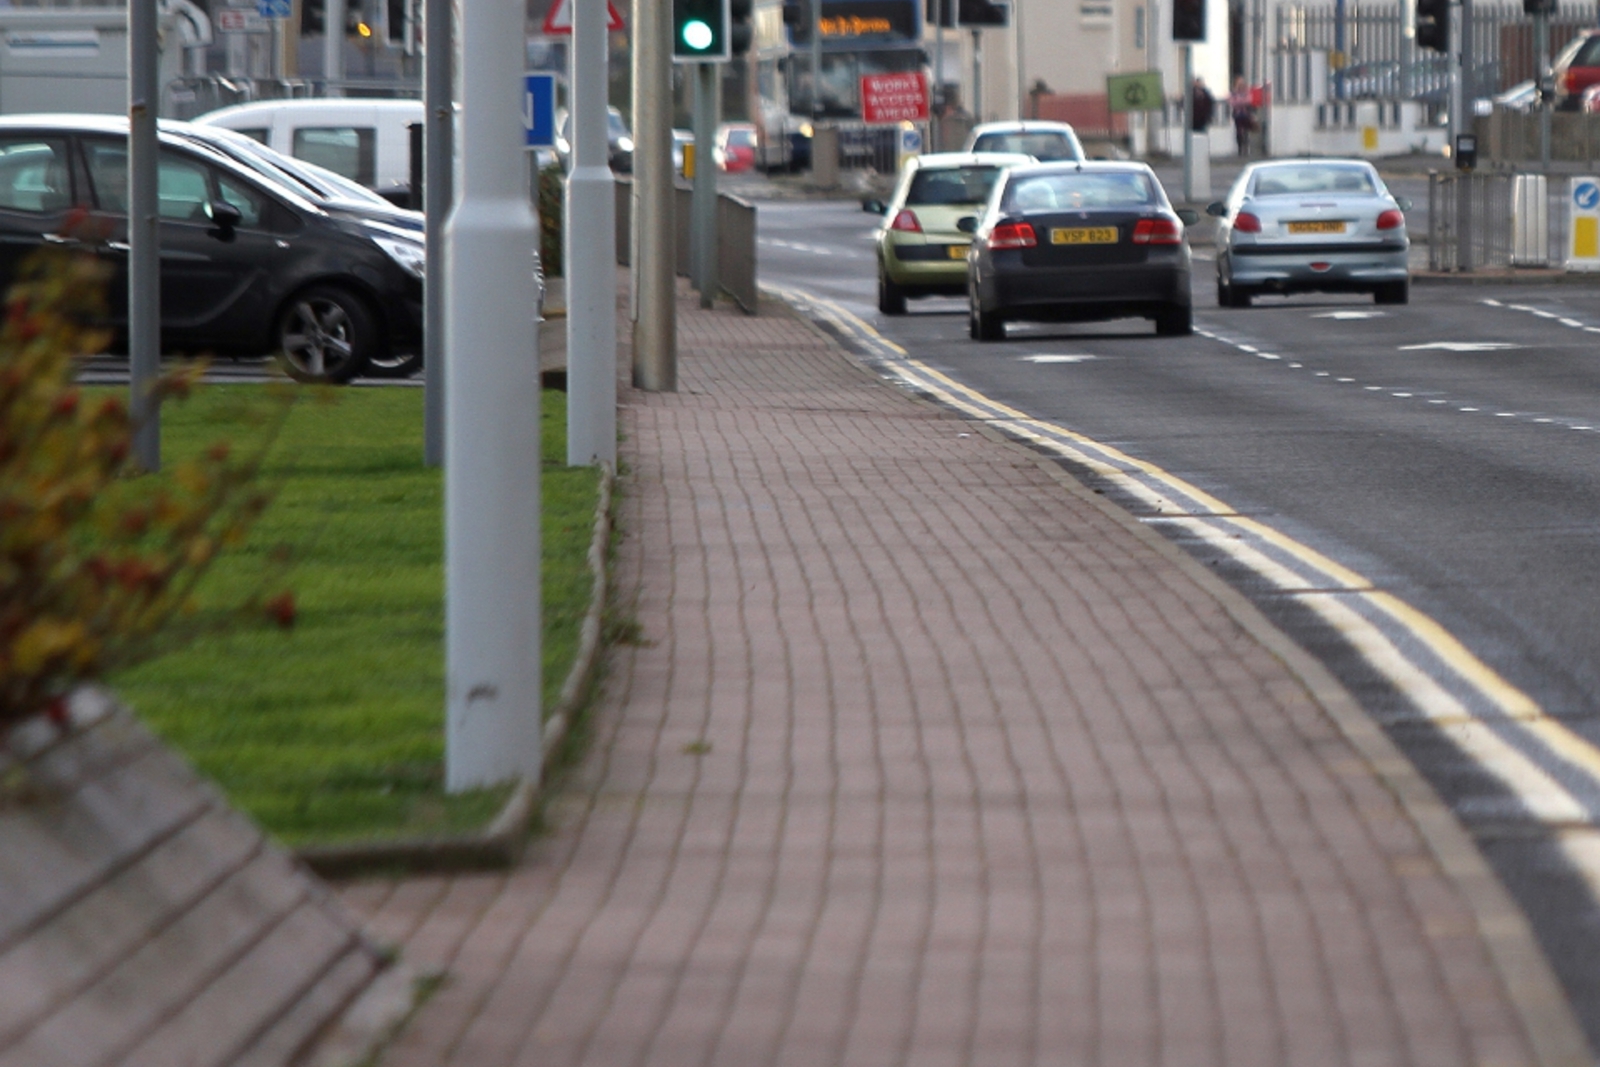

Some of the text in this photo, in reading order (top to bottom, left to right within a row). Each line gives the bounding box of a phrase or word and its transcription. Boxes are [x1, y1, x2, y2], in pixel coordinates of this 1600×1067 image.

[872, 76, 919, 93] WORKS
[871, 94, 923, 107] ACCESS
[876, 107, 919, 120] AHEAD
